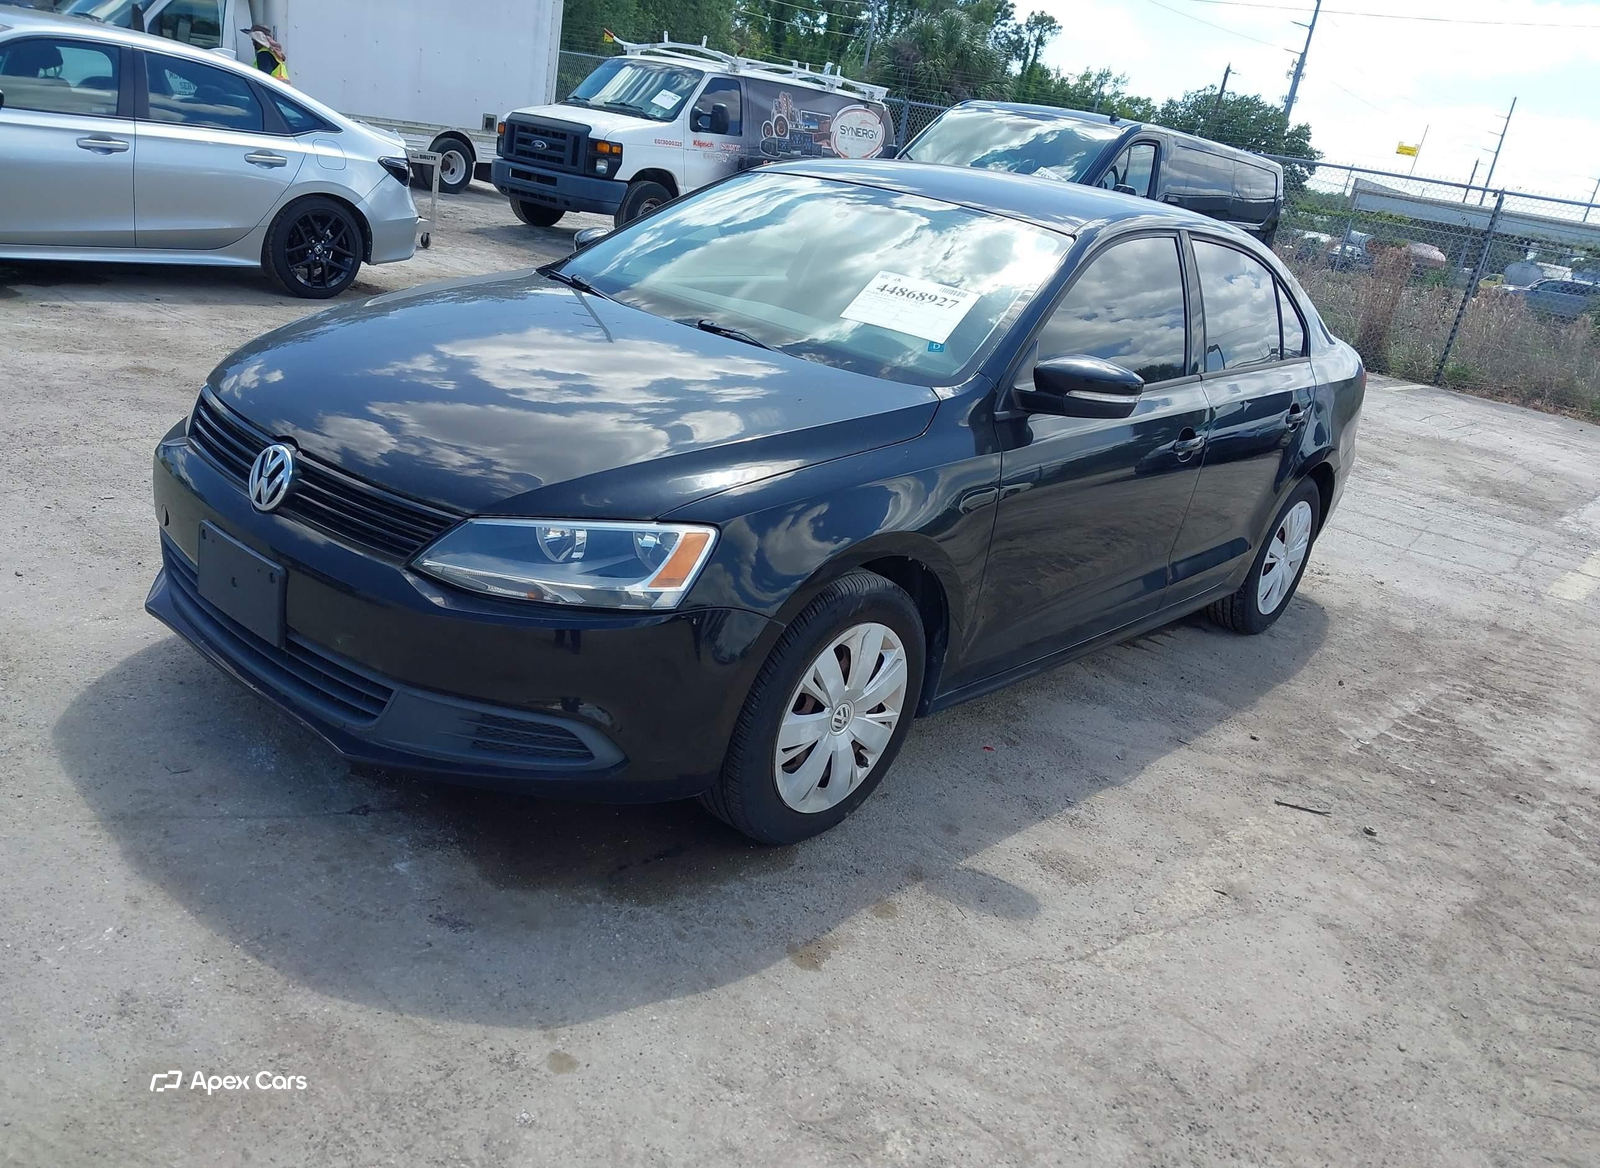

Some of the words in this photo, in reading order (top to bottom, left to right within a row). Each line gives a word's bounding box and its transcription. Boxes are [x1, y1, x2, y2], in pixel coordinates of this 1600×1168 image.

[840, 124, 878, 140] SYNERGY
[692, 139, 715, 149] Klipsch
[876, 283, 960, 309] 44868927
